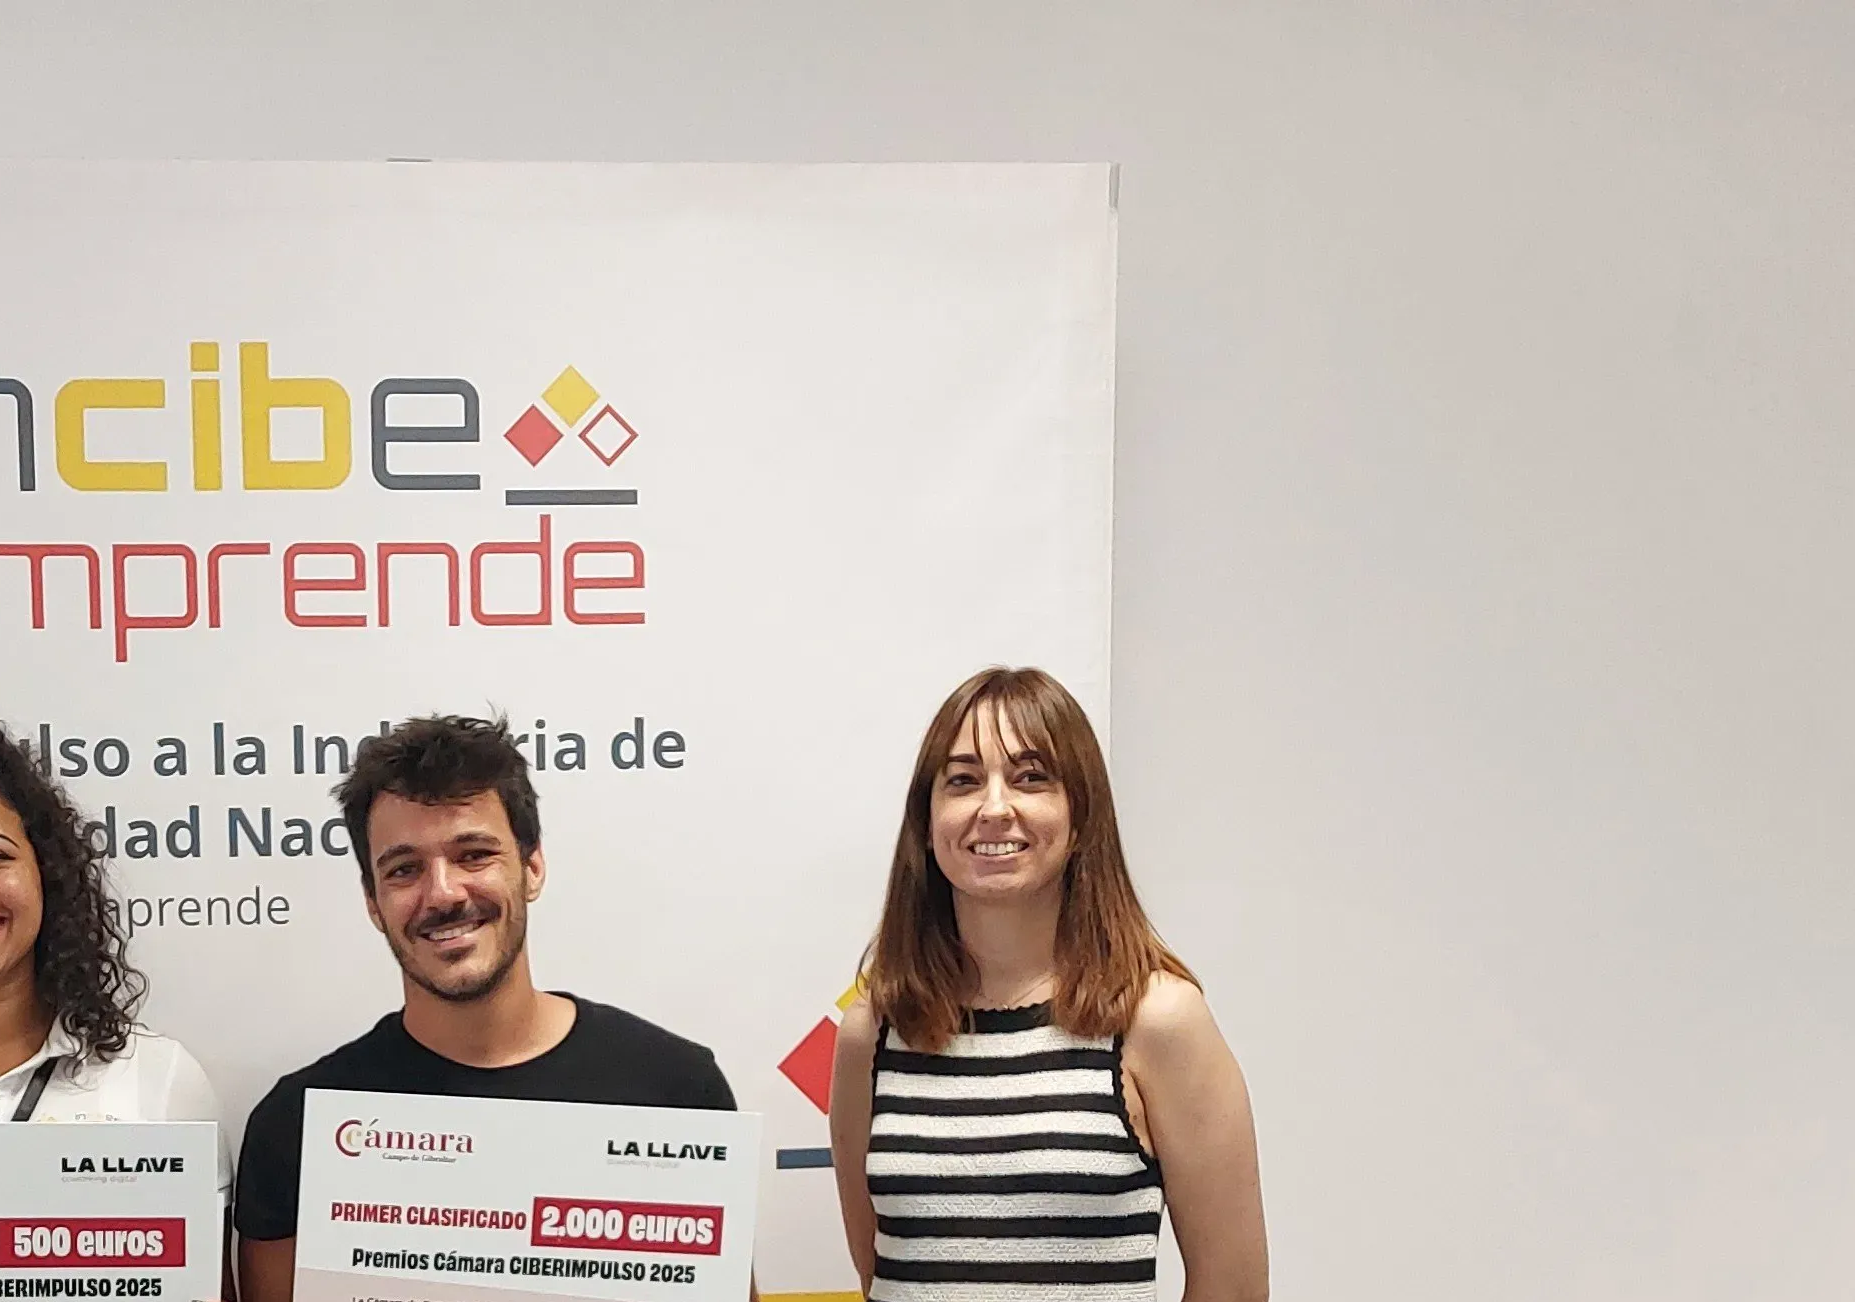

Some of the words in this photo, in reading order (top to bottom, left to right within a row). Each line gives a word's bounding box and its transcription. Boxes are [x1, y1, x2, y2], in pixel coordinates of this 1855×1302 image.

[153, 735, 188, 776] a
[213, 721, 266, 776] la
[610, 716, 687, 771] de
[335, 1118, 474, 1157] Cámara
[607, 1140, 640, 1156] LA
[647, 1142, 727, 1161] LLAVE
[61, 1157, 96, 1173] LA
[102, 1157, 184, 1173] LLAVE
[331, 1201, 402, 1224] PRIMER
[406, 1206, 527, 1230] CLASIFICADO
[540, 1205, 624, 1240] 2.000
[627, 1213, 714, 1245] euros
[13, 1226, 71, 1257] 500
[77, 1229, 164, 1257] euros
[352, 1248, 429, 1270] Premios
[433, 1251, 505, 1274] Cámara
[509, 1256, 645, 1281] CIBERIMPULSO
[649, 1263, 696, 1284] 2025
[115, 1277, 162, 1297] 2025
